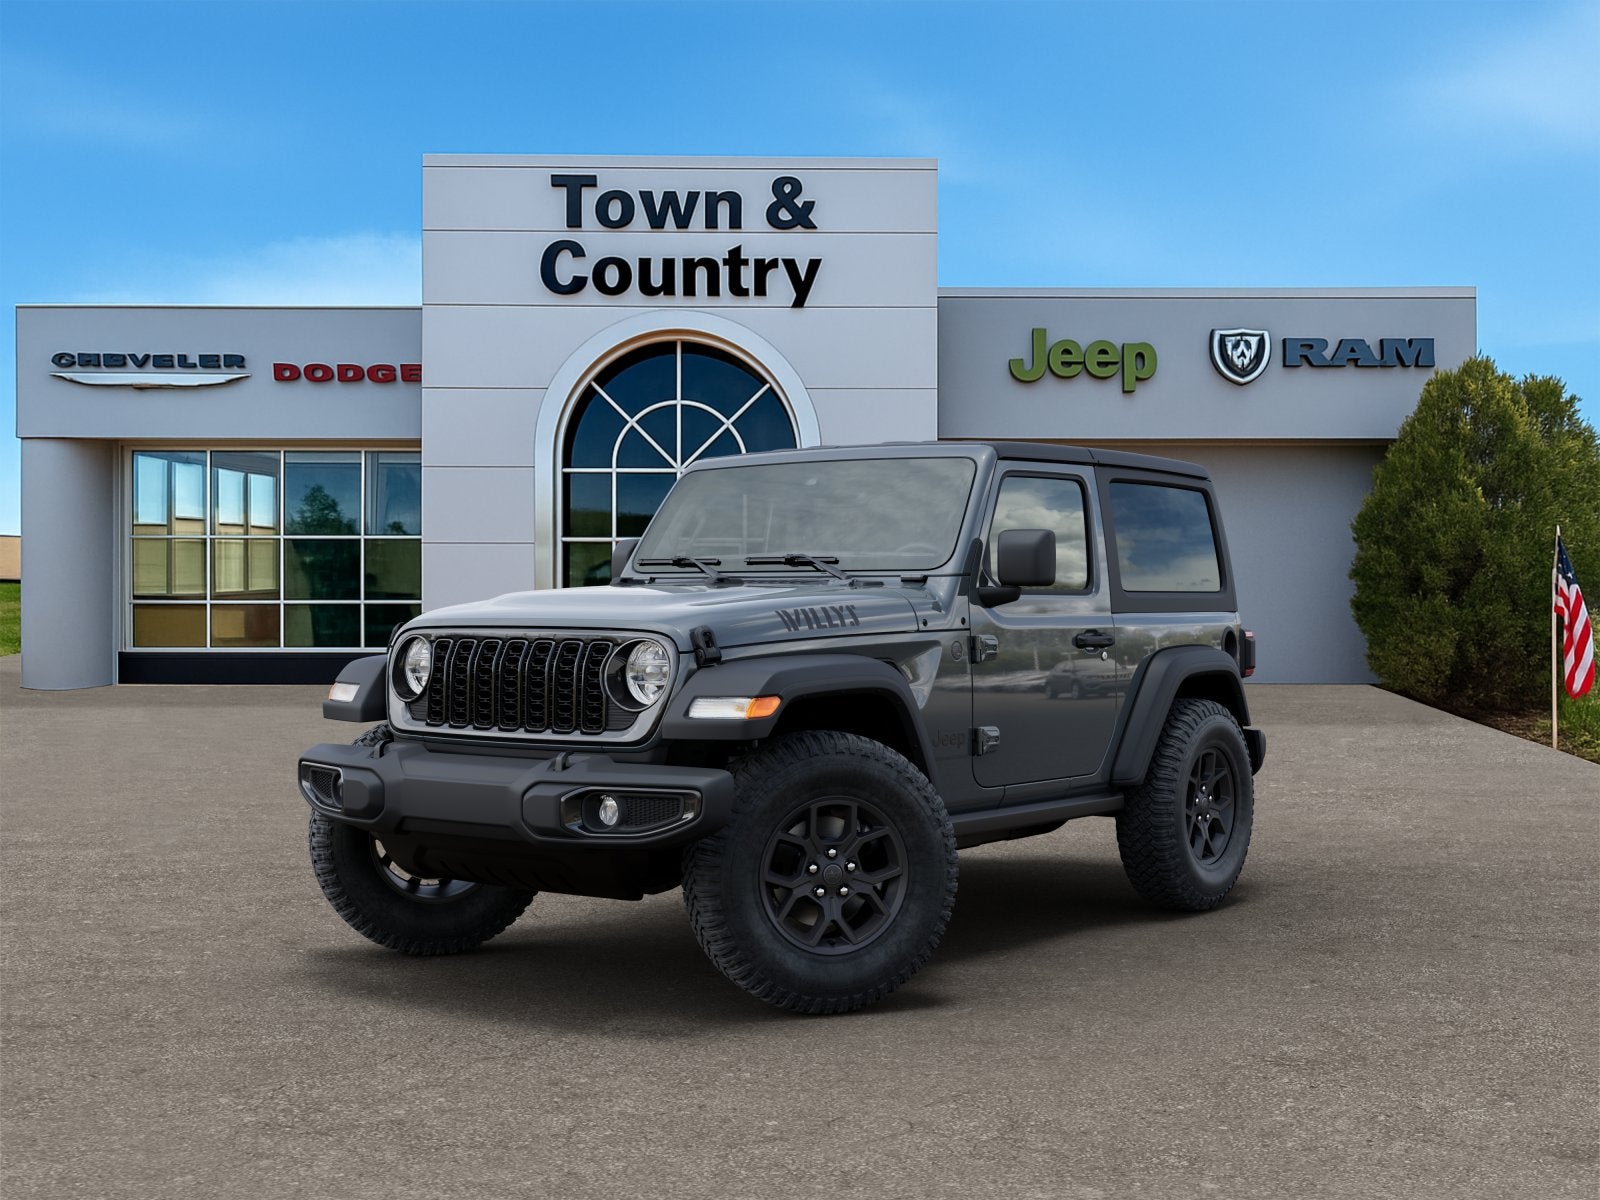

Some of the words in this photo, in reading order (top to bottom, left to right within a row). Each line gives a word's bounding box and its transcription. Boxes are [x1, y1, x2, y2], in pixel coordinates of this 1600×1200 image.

[551, 174, 742, 229] Town
[765, 175, 818, 230] &
[540, 239, 822, 308] Country
[1009, 327, 1158, 392] Jeep
[1283, 337, 1436, 367] RAM
[273, 363, 422, 382] DODGE
[775, 604, 860, 632] WILLYS
[932, 728, 966, 749] Jeep
